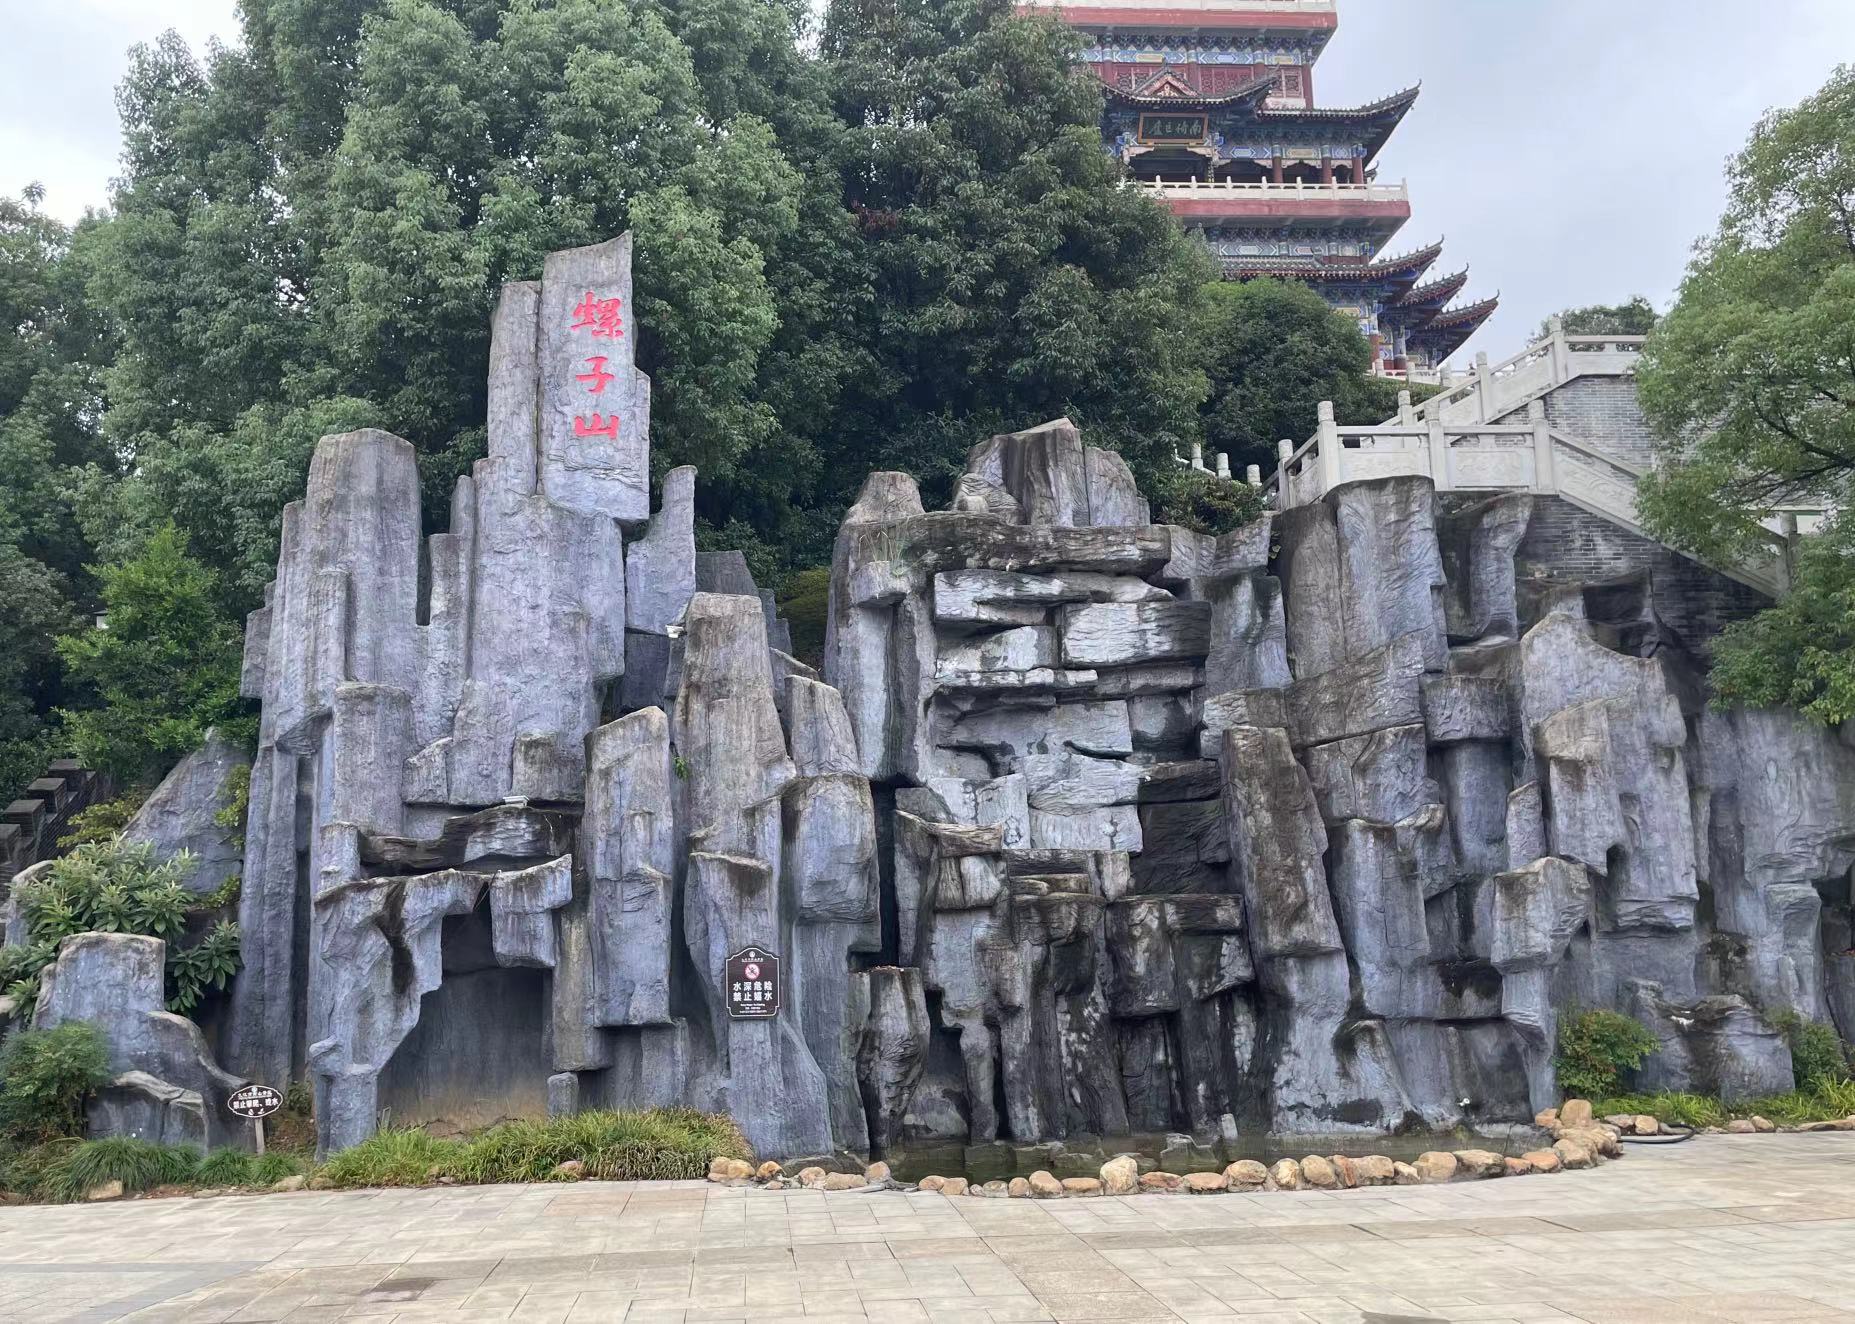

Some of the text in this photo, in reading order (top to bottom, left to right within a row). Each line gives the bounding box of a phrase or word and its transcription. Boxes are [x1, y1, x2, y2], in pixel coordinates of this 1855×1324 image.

[570, 291, 624, 440] 螺子山
[733, 981, 773, 991] 水深危险
[733, 991, 773, 1001] 禁止嬉水
